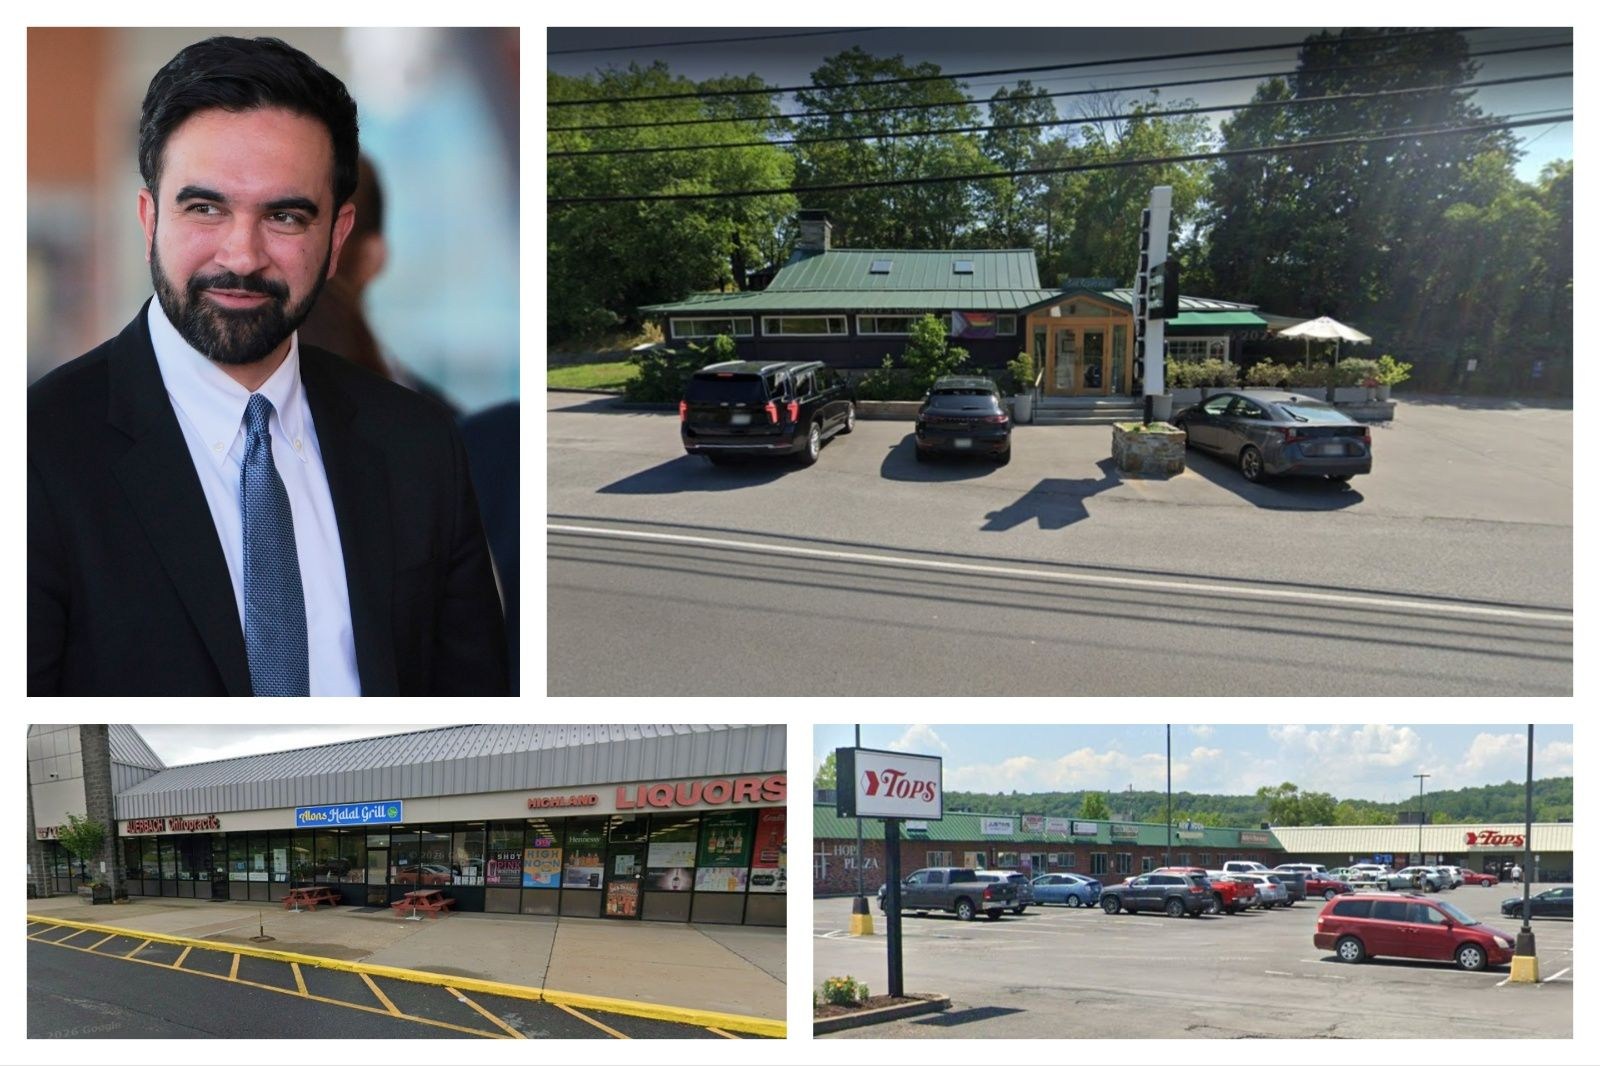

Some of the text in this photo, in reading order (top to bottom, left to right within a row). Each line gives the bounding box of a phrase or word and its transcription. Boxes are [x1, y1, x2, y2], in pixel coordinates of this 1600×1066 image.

[615, 775, 787, 811] LIQUORS
[528, 794, 599, 809] HIGHLAND
[328, 807, 359, 824] Halal
[361, 805, 386, 823] Grill
[127, 819, 165, 834] AUERBACH
[527, 850, 559, 858] HIGH
[497, 861, 521, 870] PINK
[844, 858, 879, 869] PLZA
